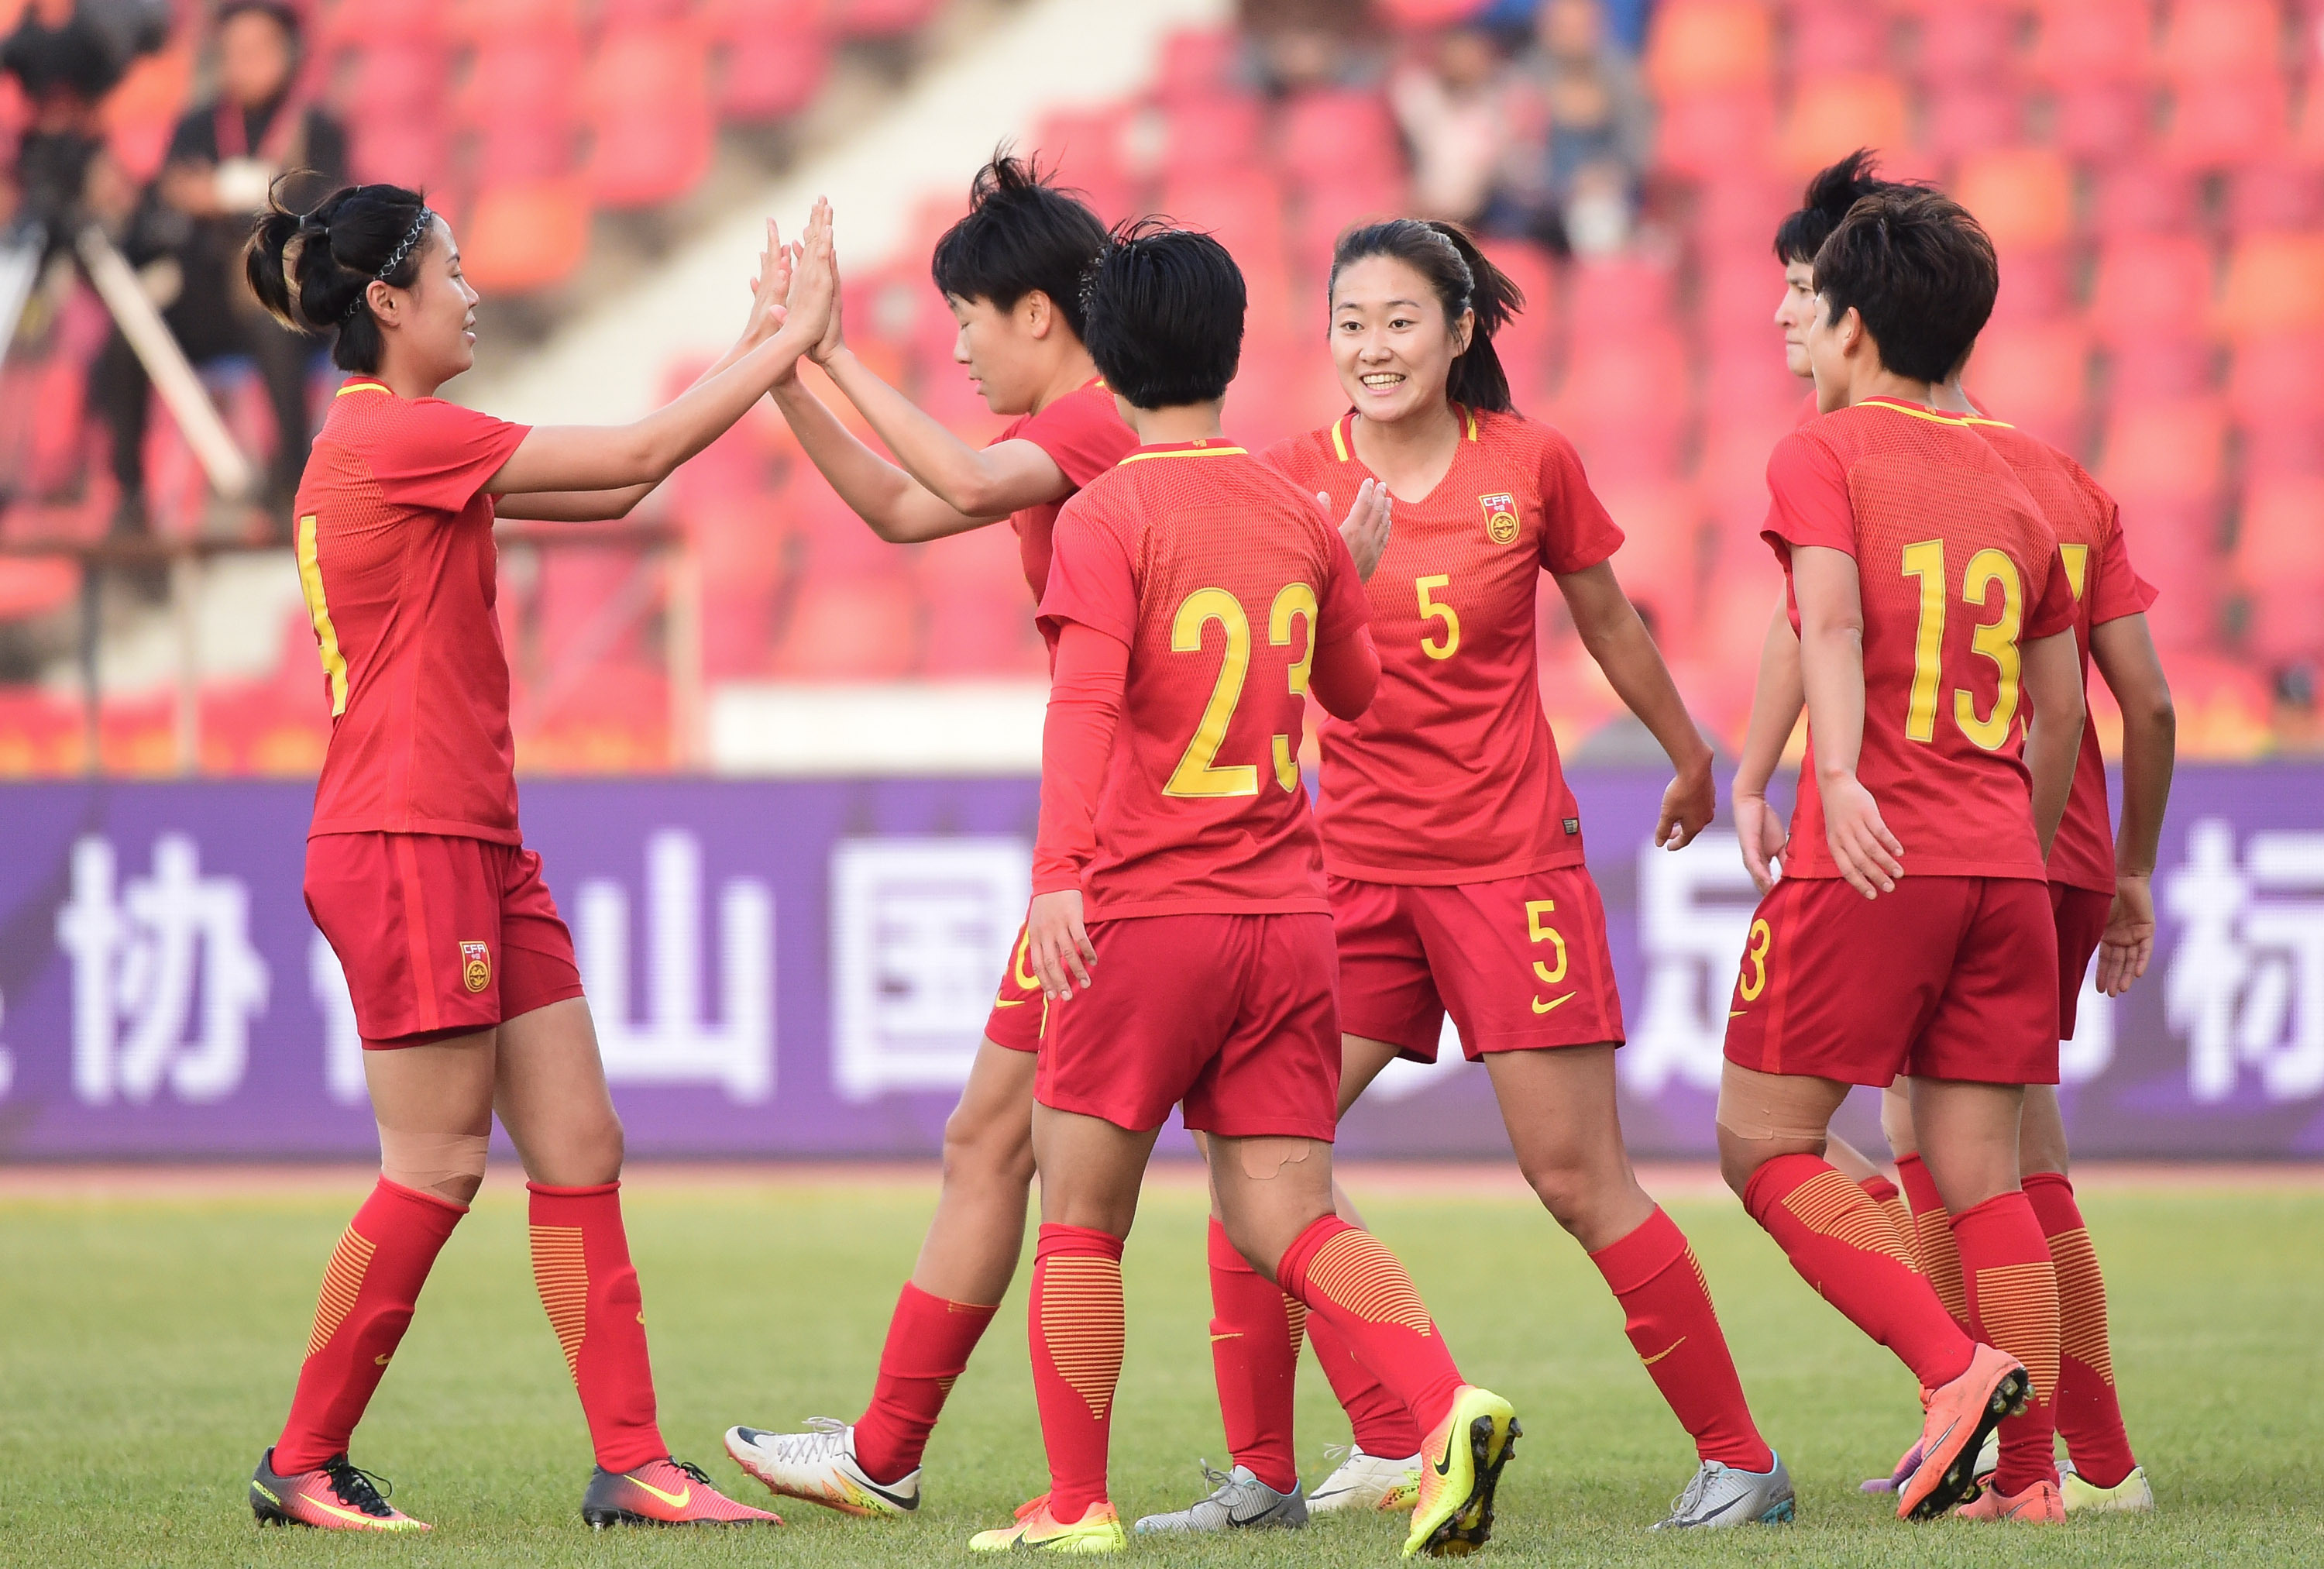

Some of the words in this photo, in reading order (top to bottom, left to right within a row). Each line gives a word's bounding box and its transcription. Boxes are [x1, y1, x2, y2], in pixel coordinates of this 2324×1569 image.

[1483, 495, 1511, 507] CFA
[1415, 574, 1460, 659] 5
[1902, 538, 2022, 751] 13
[1162, 582, 1318, 798] 23
[463, 944, 486, 954] CFA
[1525, 900, 1568, 983] 5
[1740, 918, 1771, 1002] 3
